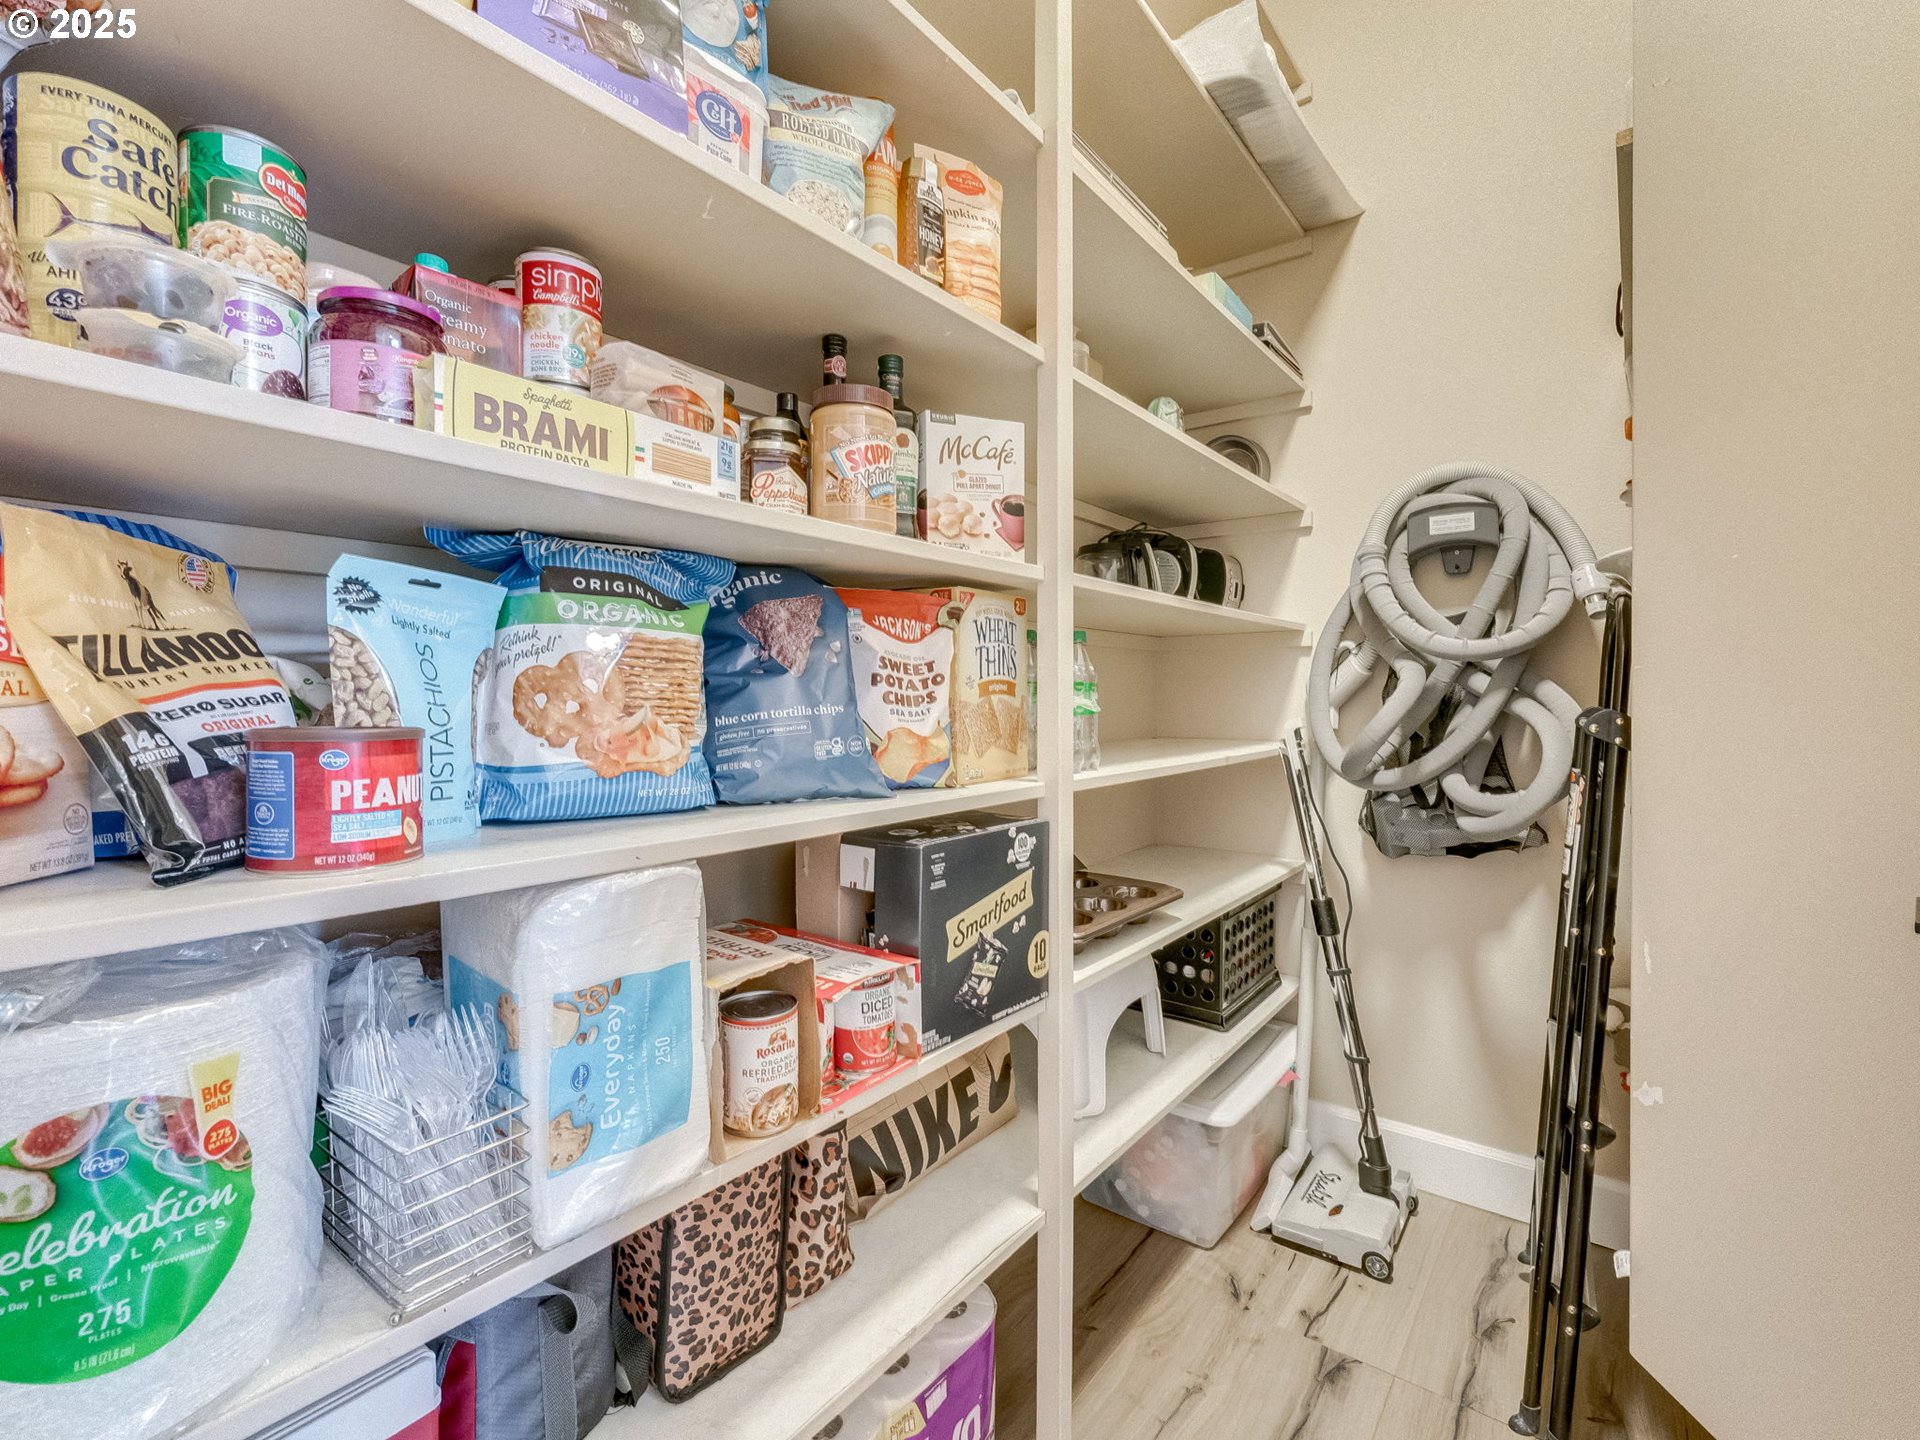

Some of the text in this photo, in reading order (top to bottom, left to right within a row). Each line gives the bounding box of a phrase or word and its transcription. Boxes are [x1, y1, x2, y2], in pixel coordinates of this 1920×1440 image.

[41, 85, 173, 147] EVERY TUNA MERCURY
[781, 112, 862, 153] ROLLED OATS
[82, 118, 176, 188] Safe
[792, 133, 858, 160] WHOLE GRAIN
[62, 145, 178, 228] Catch
[266, 172, 286, 193] Del
[919, 226, 944, 249] HONEY
[46, 265, 77, 281] AHI
[424, 289, 472, 314] Organic
[532, 288, 580, 306] Campbell's
[224, 305, 277, 327] Organic
[427, 305, 487, 339] reamy
[443, 333, 487, 354] omato
[530, 332, 564, 341] chicken
[530, 340, 561, 350] noodle
[531, 365, 548, 373] BONE
[523, 387, 573, 411] Spaghetti
[474, 392, 609, 462] BRAMI
[500, 439, 590, 469] PROTEIN PASTA
[721, 442, 733, 454] 21g
[722, 458, 732, 470] 9g
[672, 480, 686, 489] MADE
[985, 483, 1002, 491] DONUT
[347, 583, 362, 592] No
[572, 576, 663, 608] ORIGINAL
[388, 597, 461, 626] Wonderful
[557, 599, 685, 628] ORGANIC
[391, 615, 451, 639] Lightly Salted
[872, 615, 932, 640] JACKSON'S
[973, 616, 1017, 647] WHEAT
[500, 625, 541, 654] Rethink
[879, 655, 935, 677] SWEET
[870, 672, 946, 692] POTATO
[217, 692, 286, 710] SUGAR
[882, 690, 938, 708] CHIPS
[414, 642, 455, 802] PISTACHIOS
[715, 704, 844, 727] blue corn tortilla chips
[889, 707, 931, 718] SEA SALT
[200, 714, 276, 733] ORIGINAL
[719, 732, 738, 742] gluten
[737, 730, 750, 741] free
[766, 725, 807, 735] preservatives
[129, 747, 180, 768] PROTEIN
[321, 753, 349, 767] Kroger
[331, 773, 423, 811] PEANU
[638, 787, 690, 797] NET WT 28 OZ
[333, 815, 361, 824] LIGHTLY
[362, 813, 386, 822] SALTED
[333, 823, 347, 831] SEA
[349, 821, 365, 830] SALT
[223, 840, 236, 849] NO
[333, 831, 371, 841] LOW SODIUM
[29, 862, 41, 872] NET
[42, 861, 51, 870] WT
[202, 850, 240, 864] TOTAL CARBS
[314, 852, 375, 865] NET WT 12 OZ (340g)
[953, 881, 1027, 949] Smartfood
[1034, 938, 1046, 963] 10
[1034, 963, 1046, 972] BAGS
[865, 986, 890, 1001] ORGANIC
[861, 995, 893, 1015] DICED
[862, 1009, 893, 1025] TOMATOES
[627, 1023, 637, 1095] NAPKINS
[655, 1036, 671, 1065] 250
[761, 1052, 794, 1068] ORGANIC
[600, 1004, 625, 1130] Everyday
[742, 1065, 783, 1078] REFRIED
[201, 1079, 233, 1103] BIG
[204, 1095, 231, 1114] DEAL!
[210, 1127, 231, 1143] 275
[848, 1066, 980, 1197] NIKE
[209, 1136, 234, 1151] PLATES
[82, 1155, 126, 1174] Kroger
[0, 1184, 238, 1276] elebration
[108, 1216, 226, 1269] PLATES
[8, 1301, 29, 1313] Day
[50, 1289, 87, 1303] Grease
[89, 1276, 118, 1293] Proof
[78, 1299, 131, 1337] 275
[88, 1327, 122, 1344] PLATES
